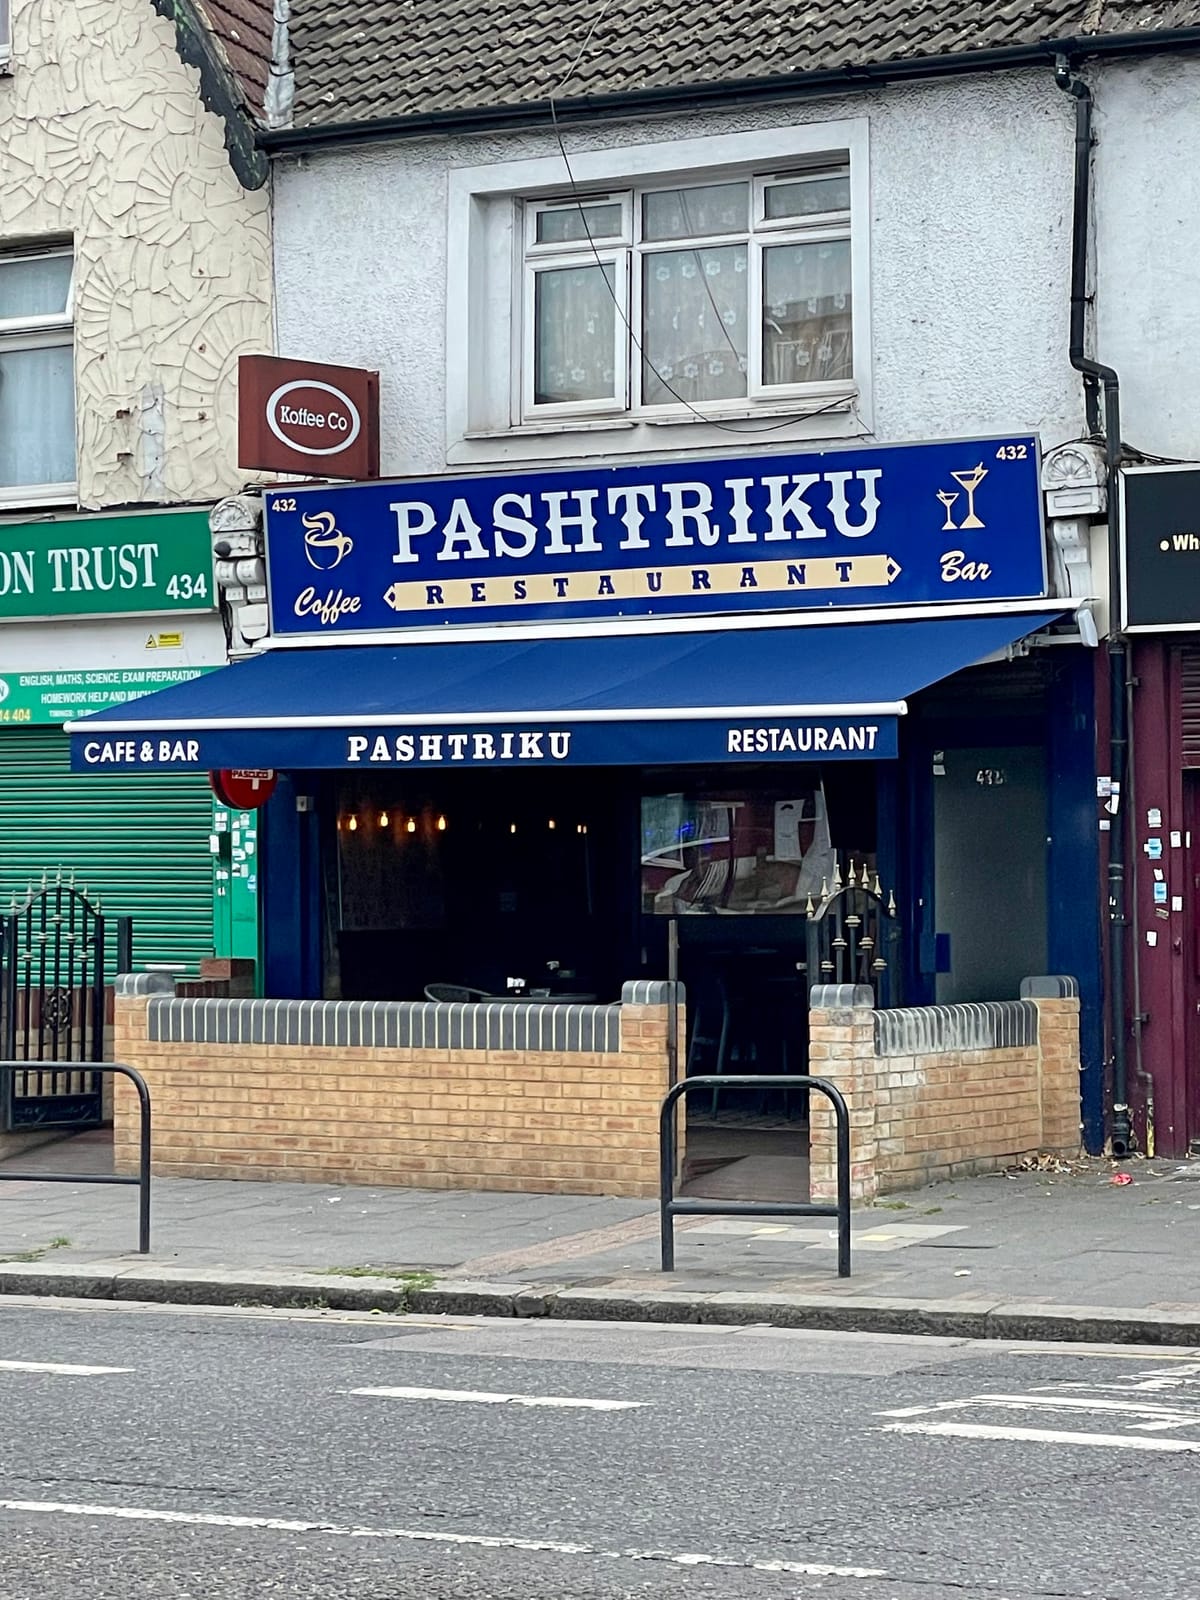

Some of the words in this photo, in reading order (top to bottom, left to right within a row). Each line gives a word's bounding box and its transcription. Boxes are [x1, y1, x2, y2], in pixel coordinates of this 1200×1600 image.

[280, 405, 325, 428] Koffee
[327, 411, 348, 431] Co
[995, 445, 1028, 461] 432
[271, 498, 297, 513] 432
[389, 468, 883, 564] PASHTRIKU
[1172, 533, 1200, 551] Wh
[47, 543, 159, 593] TRUST
[939, 550, 992, 582] Bar
[165, 573, 208, 600] 434
[426, 561, 853, 605] RESTAURANT
[293, 587, 362, 625] Coffee
[56, 673, 84, 685] MATHS,
[85, 671, 121, 685] SCIENCE,
[122, 671, 146, 684] EXAM
[146, 670, 201, 683] PREPARATION
[41, 691, 87, 704] HOMEWORK
[88, 691, 110, 703] HELP
[110, 690, 127, 703] AND
[12, 708, 31, 721] 404
[83, 741, 136, 763] CAFE
[139, 741, 154, 762] &
[158, 740, 200, 762] BAR
[347, 732, 572, 762] PASHTRIKU
[727, 726, 878, 753] RESTAURANT
